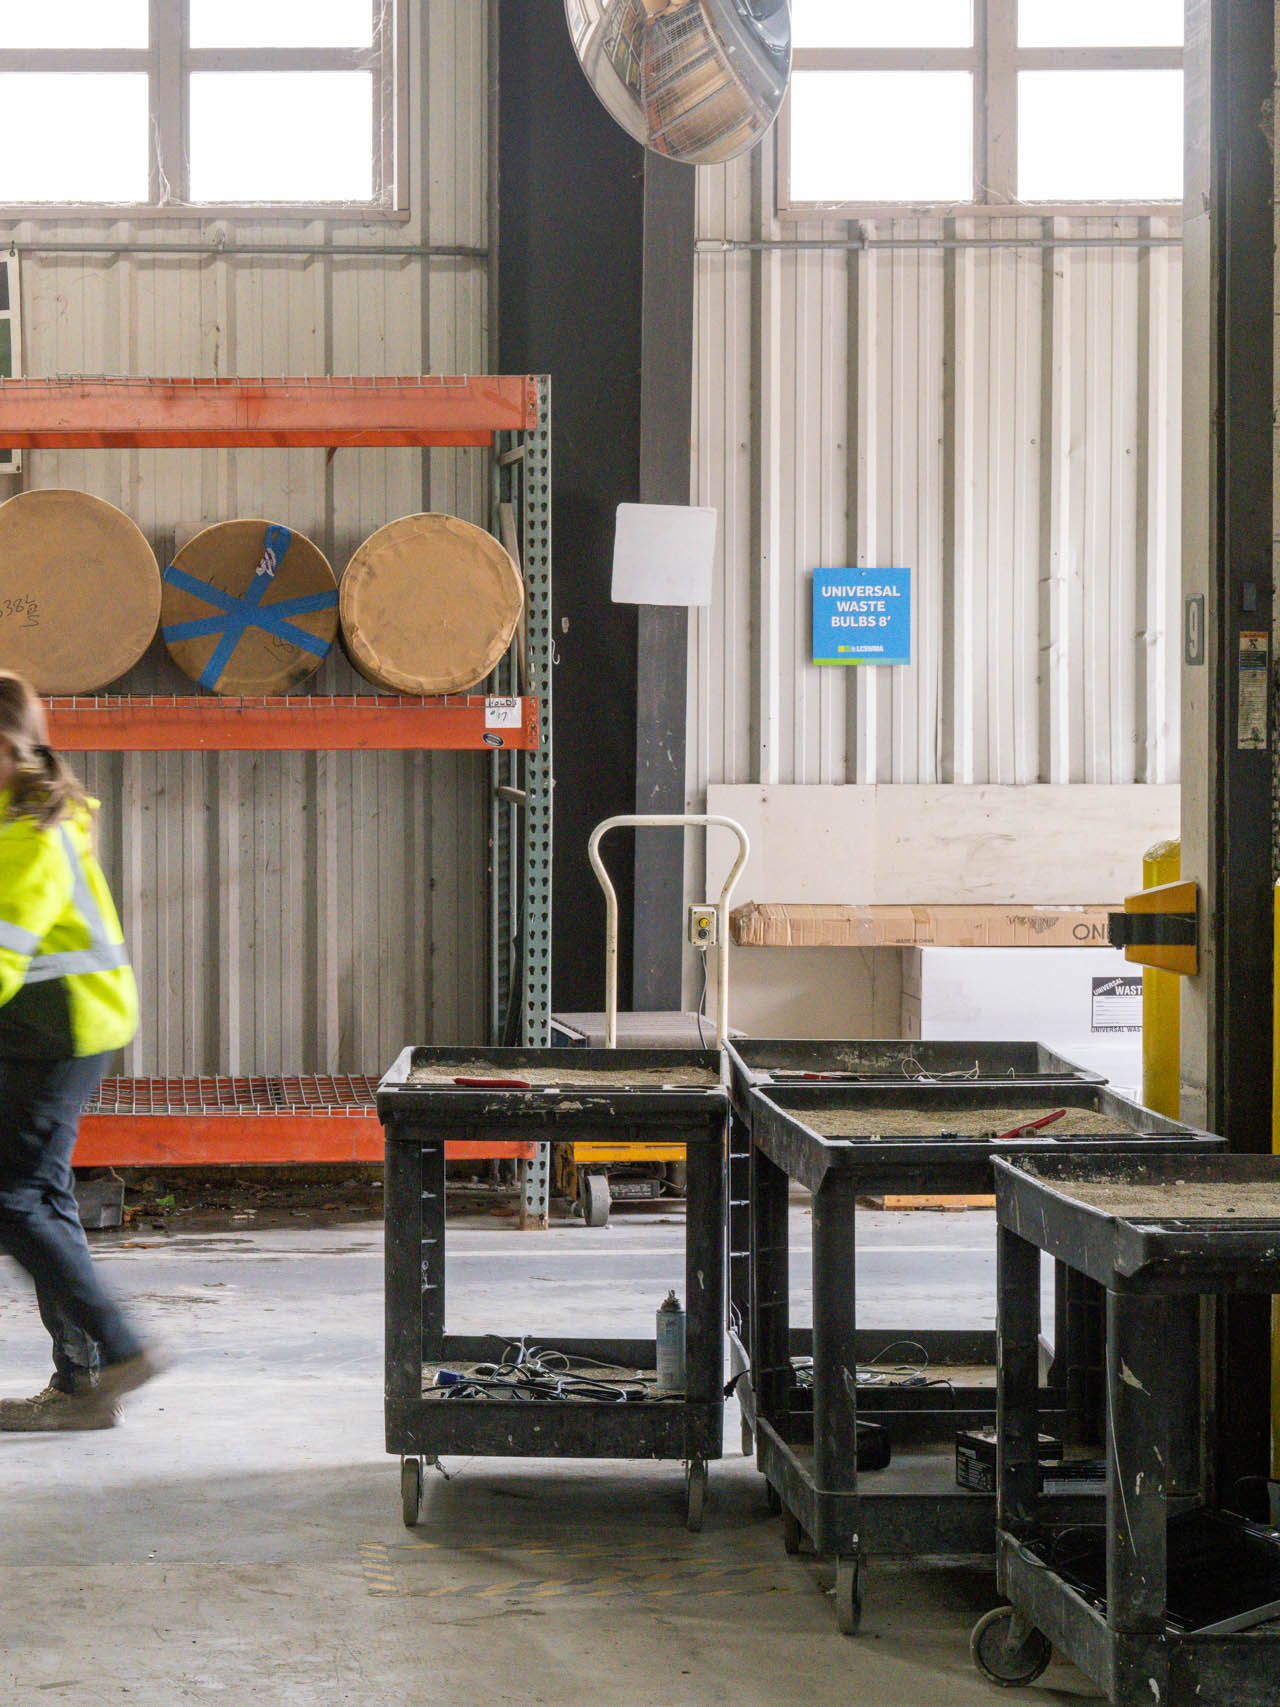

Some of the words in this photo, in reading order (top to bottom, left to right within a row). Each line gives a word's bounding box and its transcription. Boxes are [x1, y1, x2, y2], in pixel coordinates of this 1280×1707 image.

[821, 585, 901, 597] UNIVERSAL
[836, 600, 886, 612] WASTE
[831, 616, 876, 627] BULBS
[1092, 977, 1124, 996] UNIVERSAL
